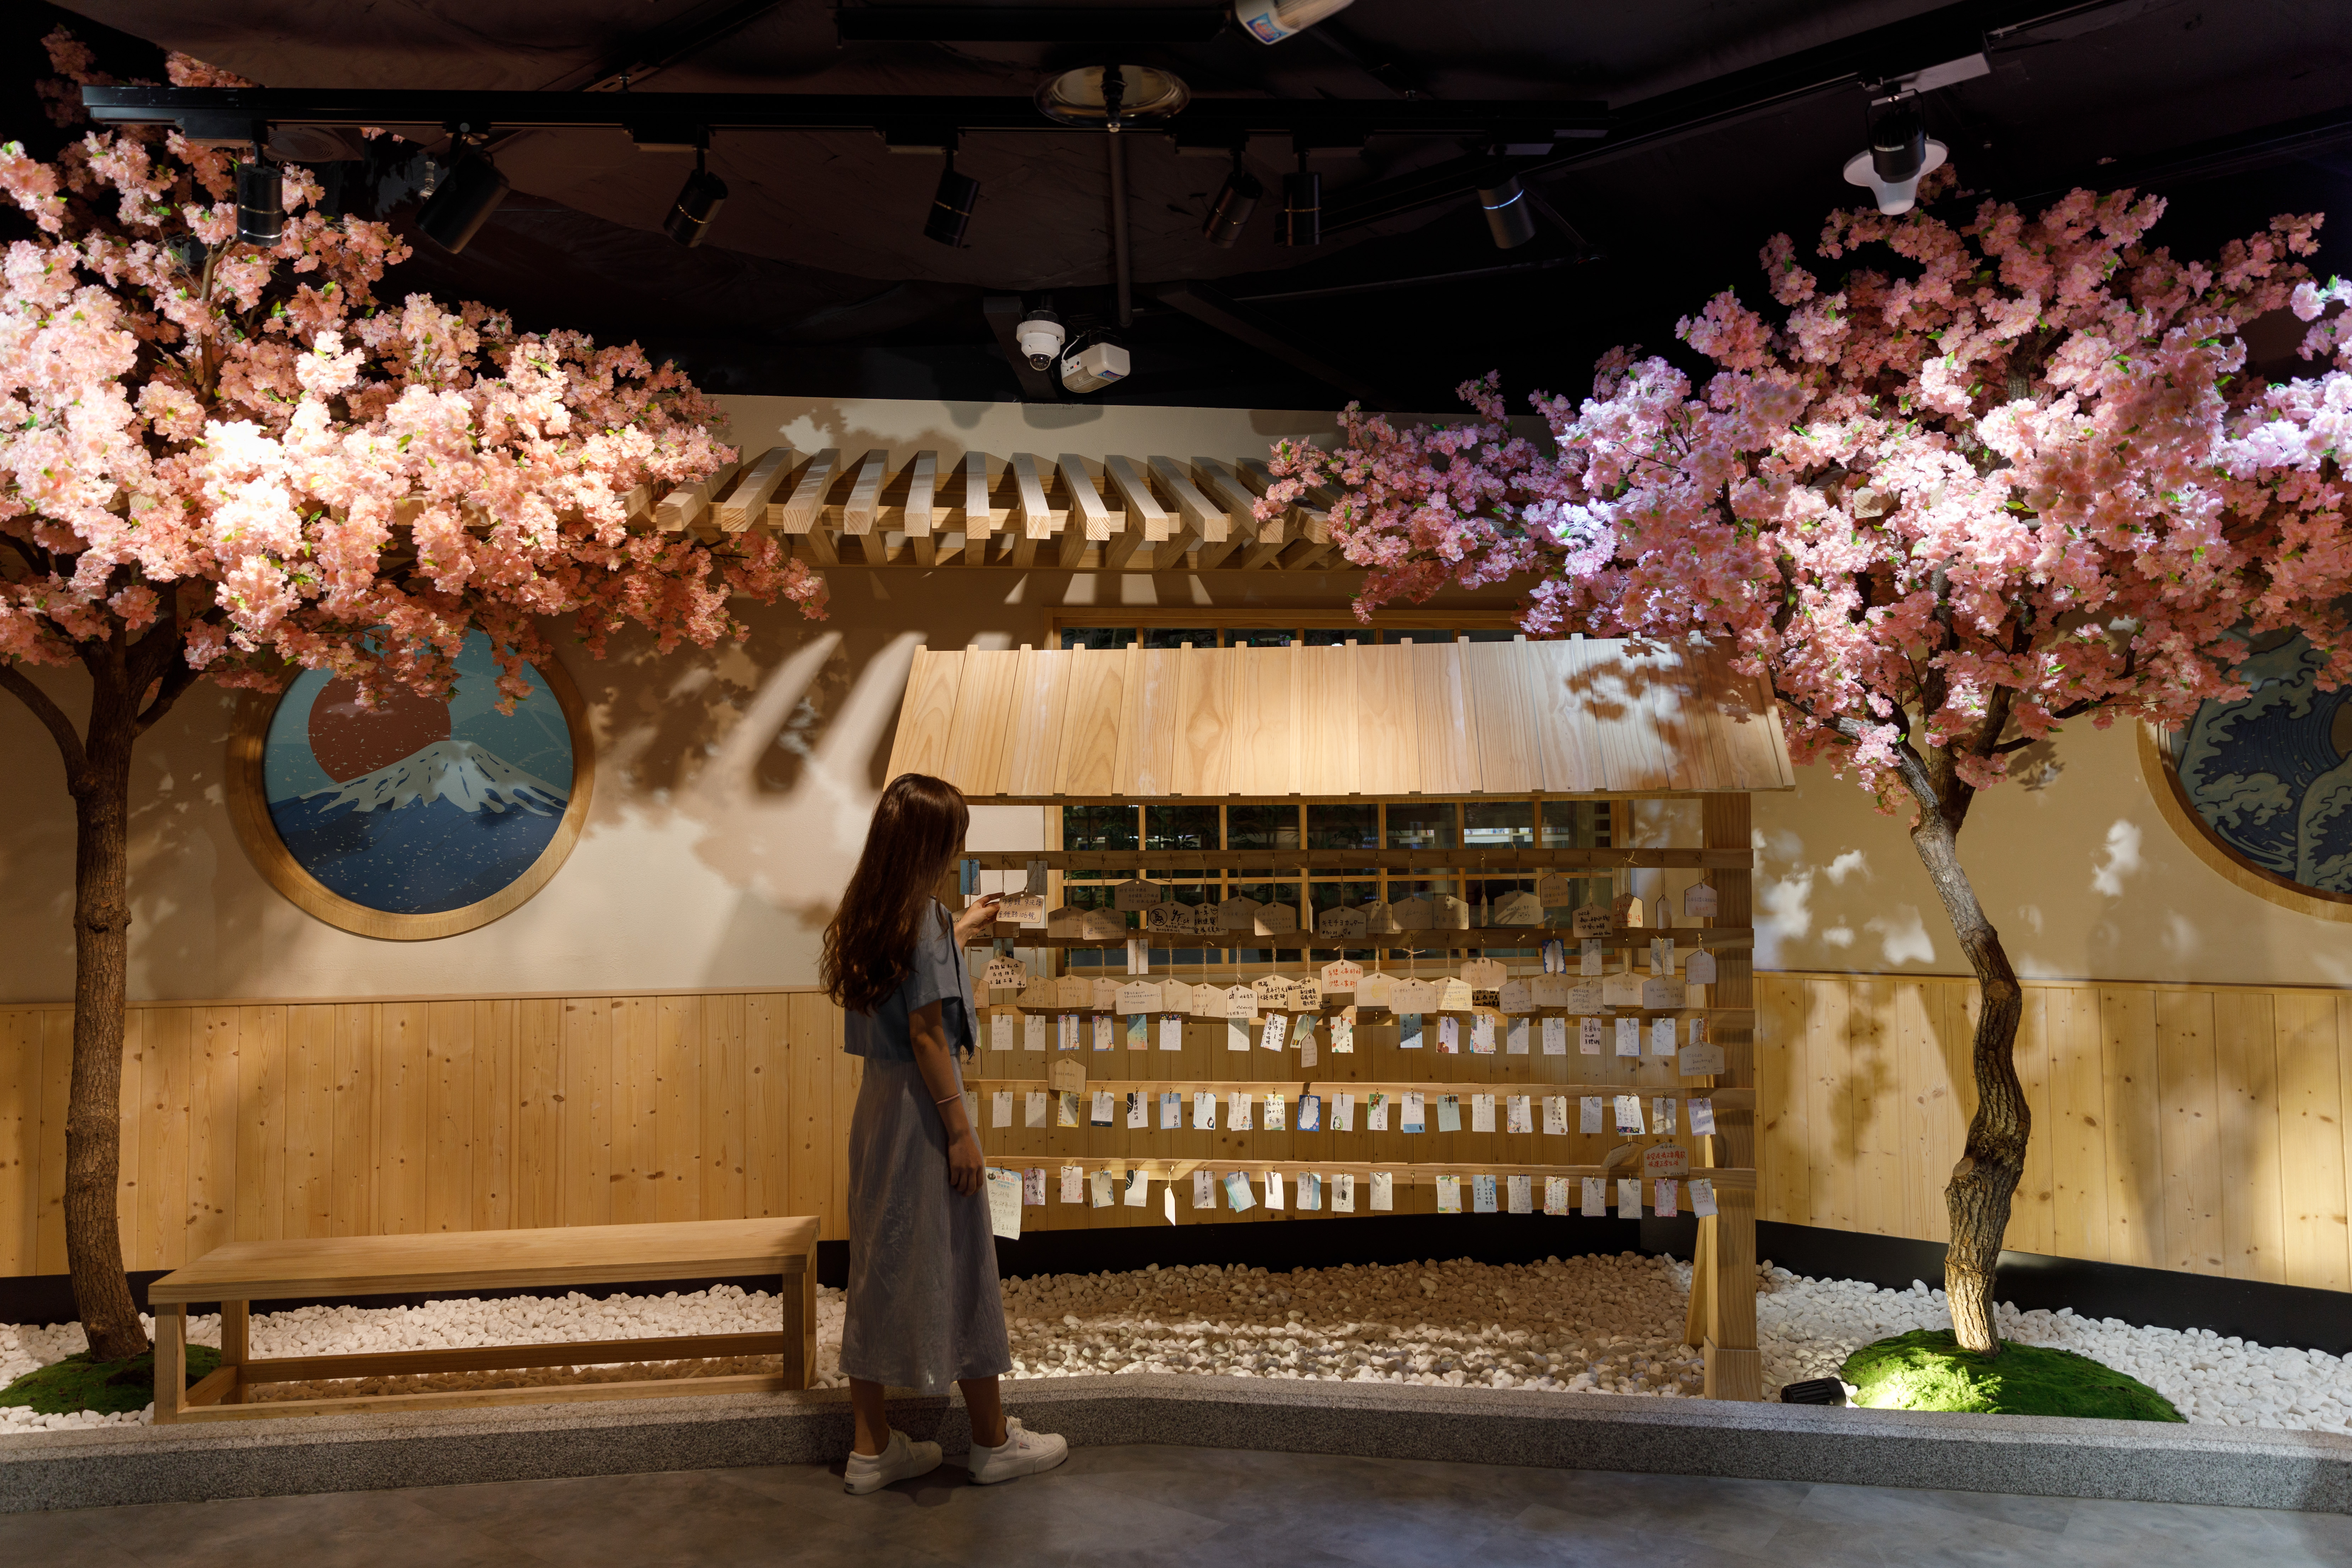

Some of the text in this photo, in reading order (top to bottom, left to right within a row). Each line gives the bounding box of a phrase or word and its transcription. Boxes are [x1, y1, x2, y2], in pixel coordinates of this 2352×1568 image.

[1329, 979, 1357, 988] 少想人家的
